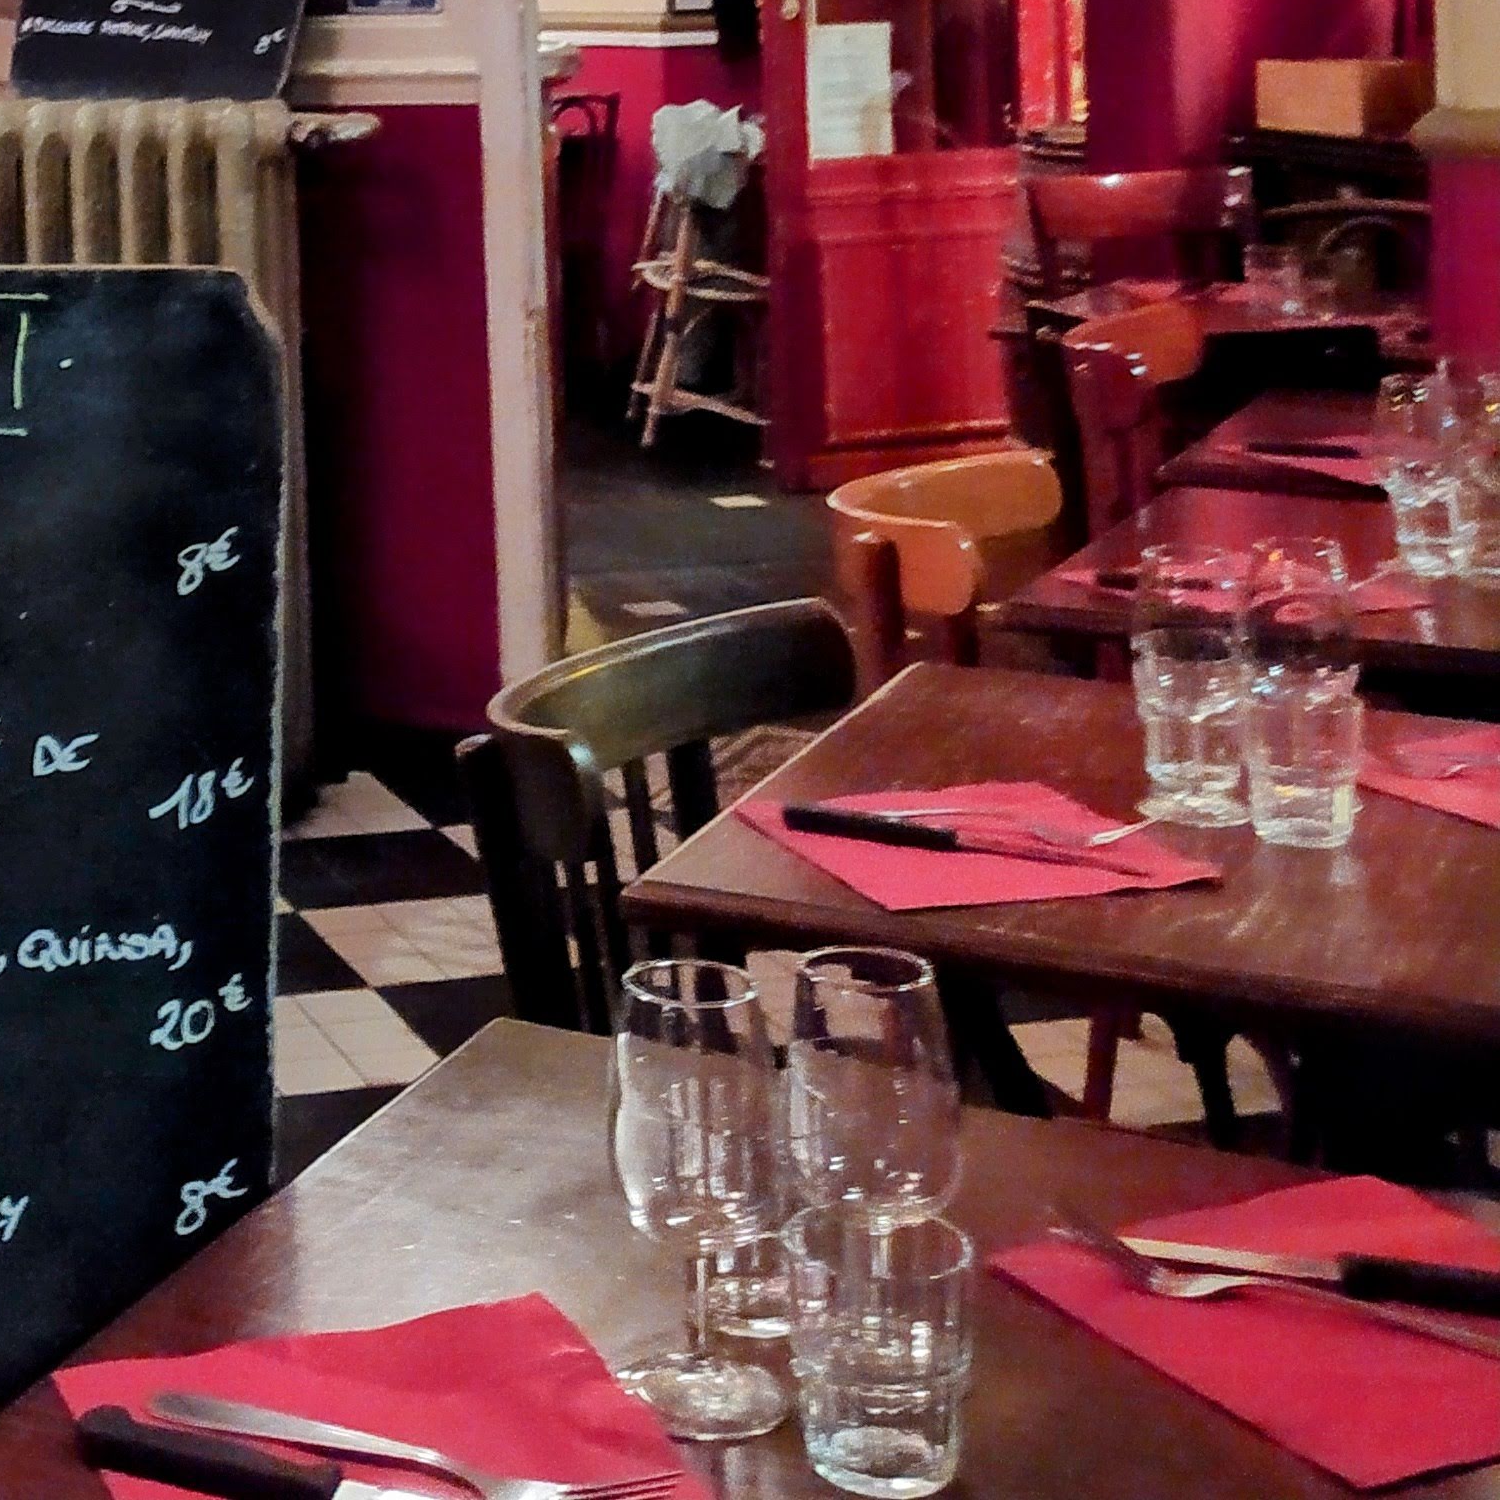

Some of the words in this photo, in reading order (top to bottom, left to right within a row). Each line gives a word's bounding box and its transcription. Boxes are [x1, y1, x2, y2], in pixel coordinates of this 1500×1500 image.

[176, 526, 241, 596] 8€
[32, 733, 100, 777] DE
[147, 756, 255, 830] 18€
[149, 971, 254, 1052] 20€
[174, 1157, 249, 1236] 8€
